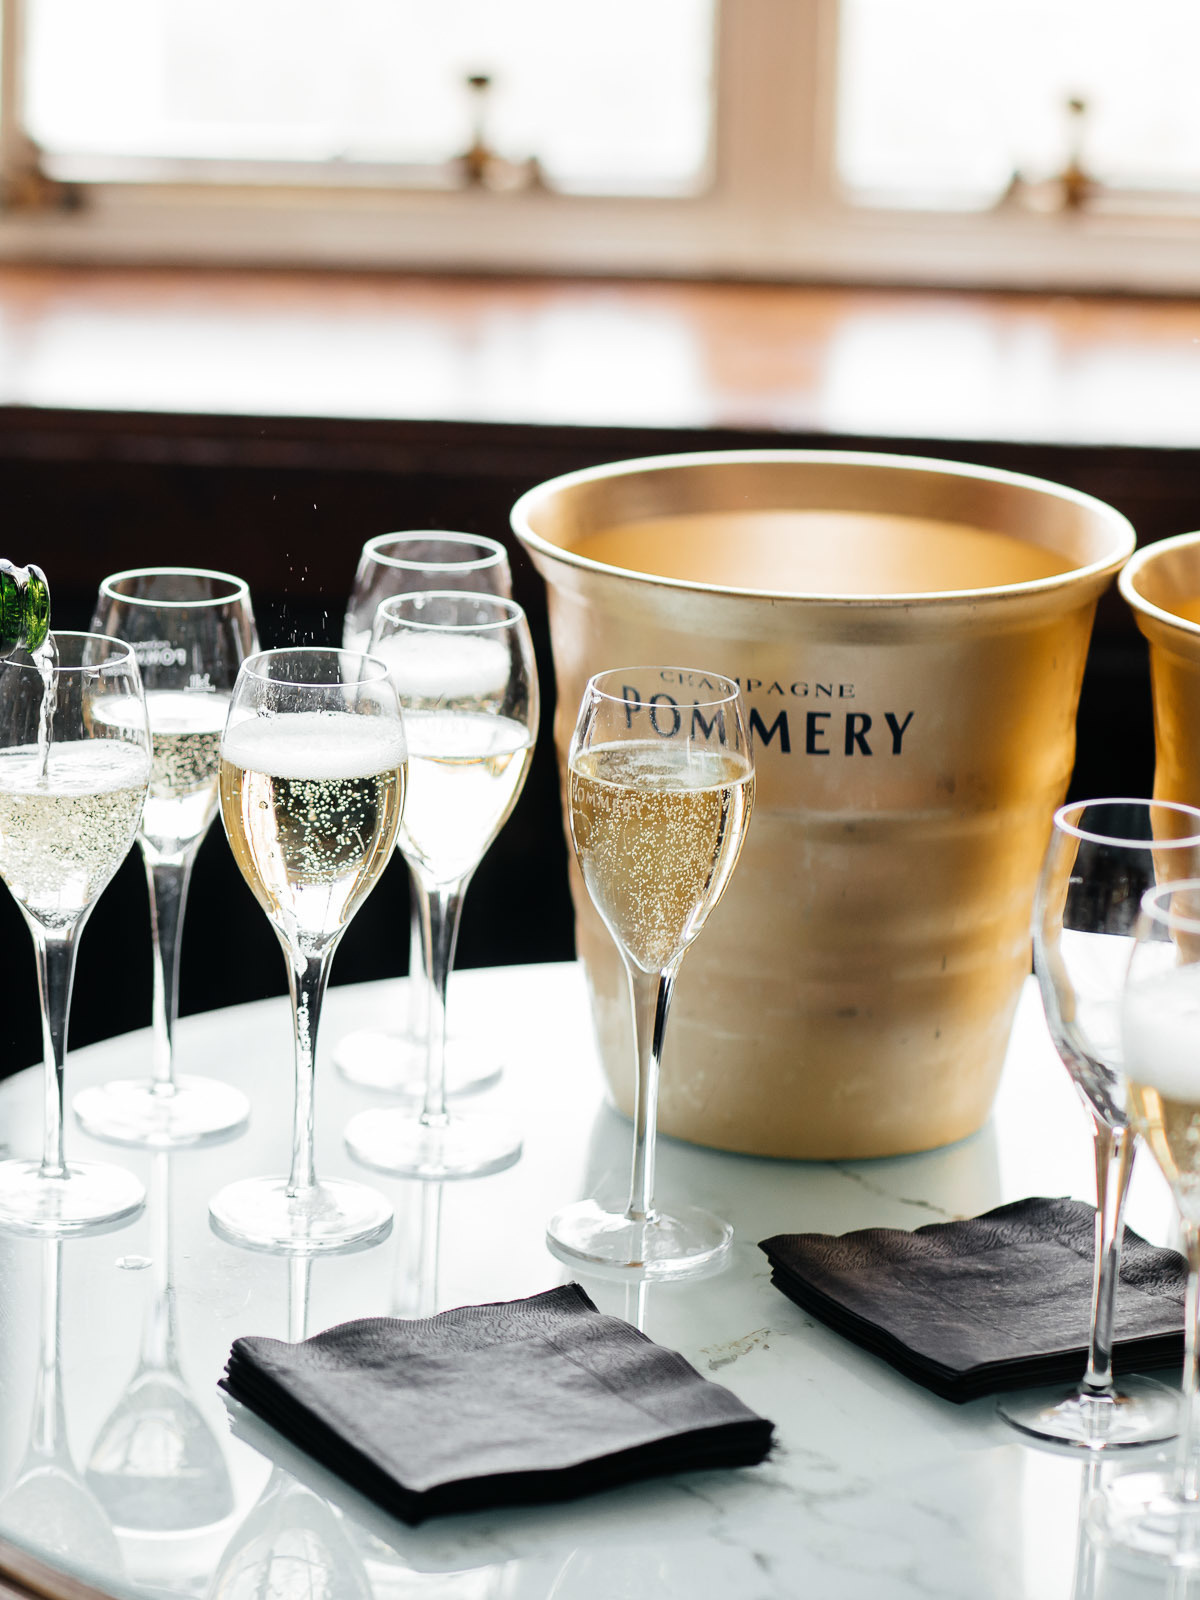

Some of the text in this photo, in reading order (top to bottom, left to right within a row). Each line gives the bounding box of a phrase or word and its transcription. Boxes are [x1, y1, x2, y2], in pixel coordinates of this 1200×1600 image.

[659, 670, 856, 699] CHAMPAGNE
[622, 685, 915, 756] POMMERY
[573, 782, 644, 818] POMMERY
